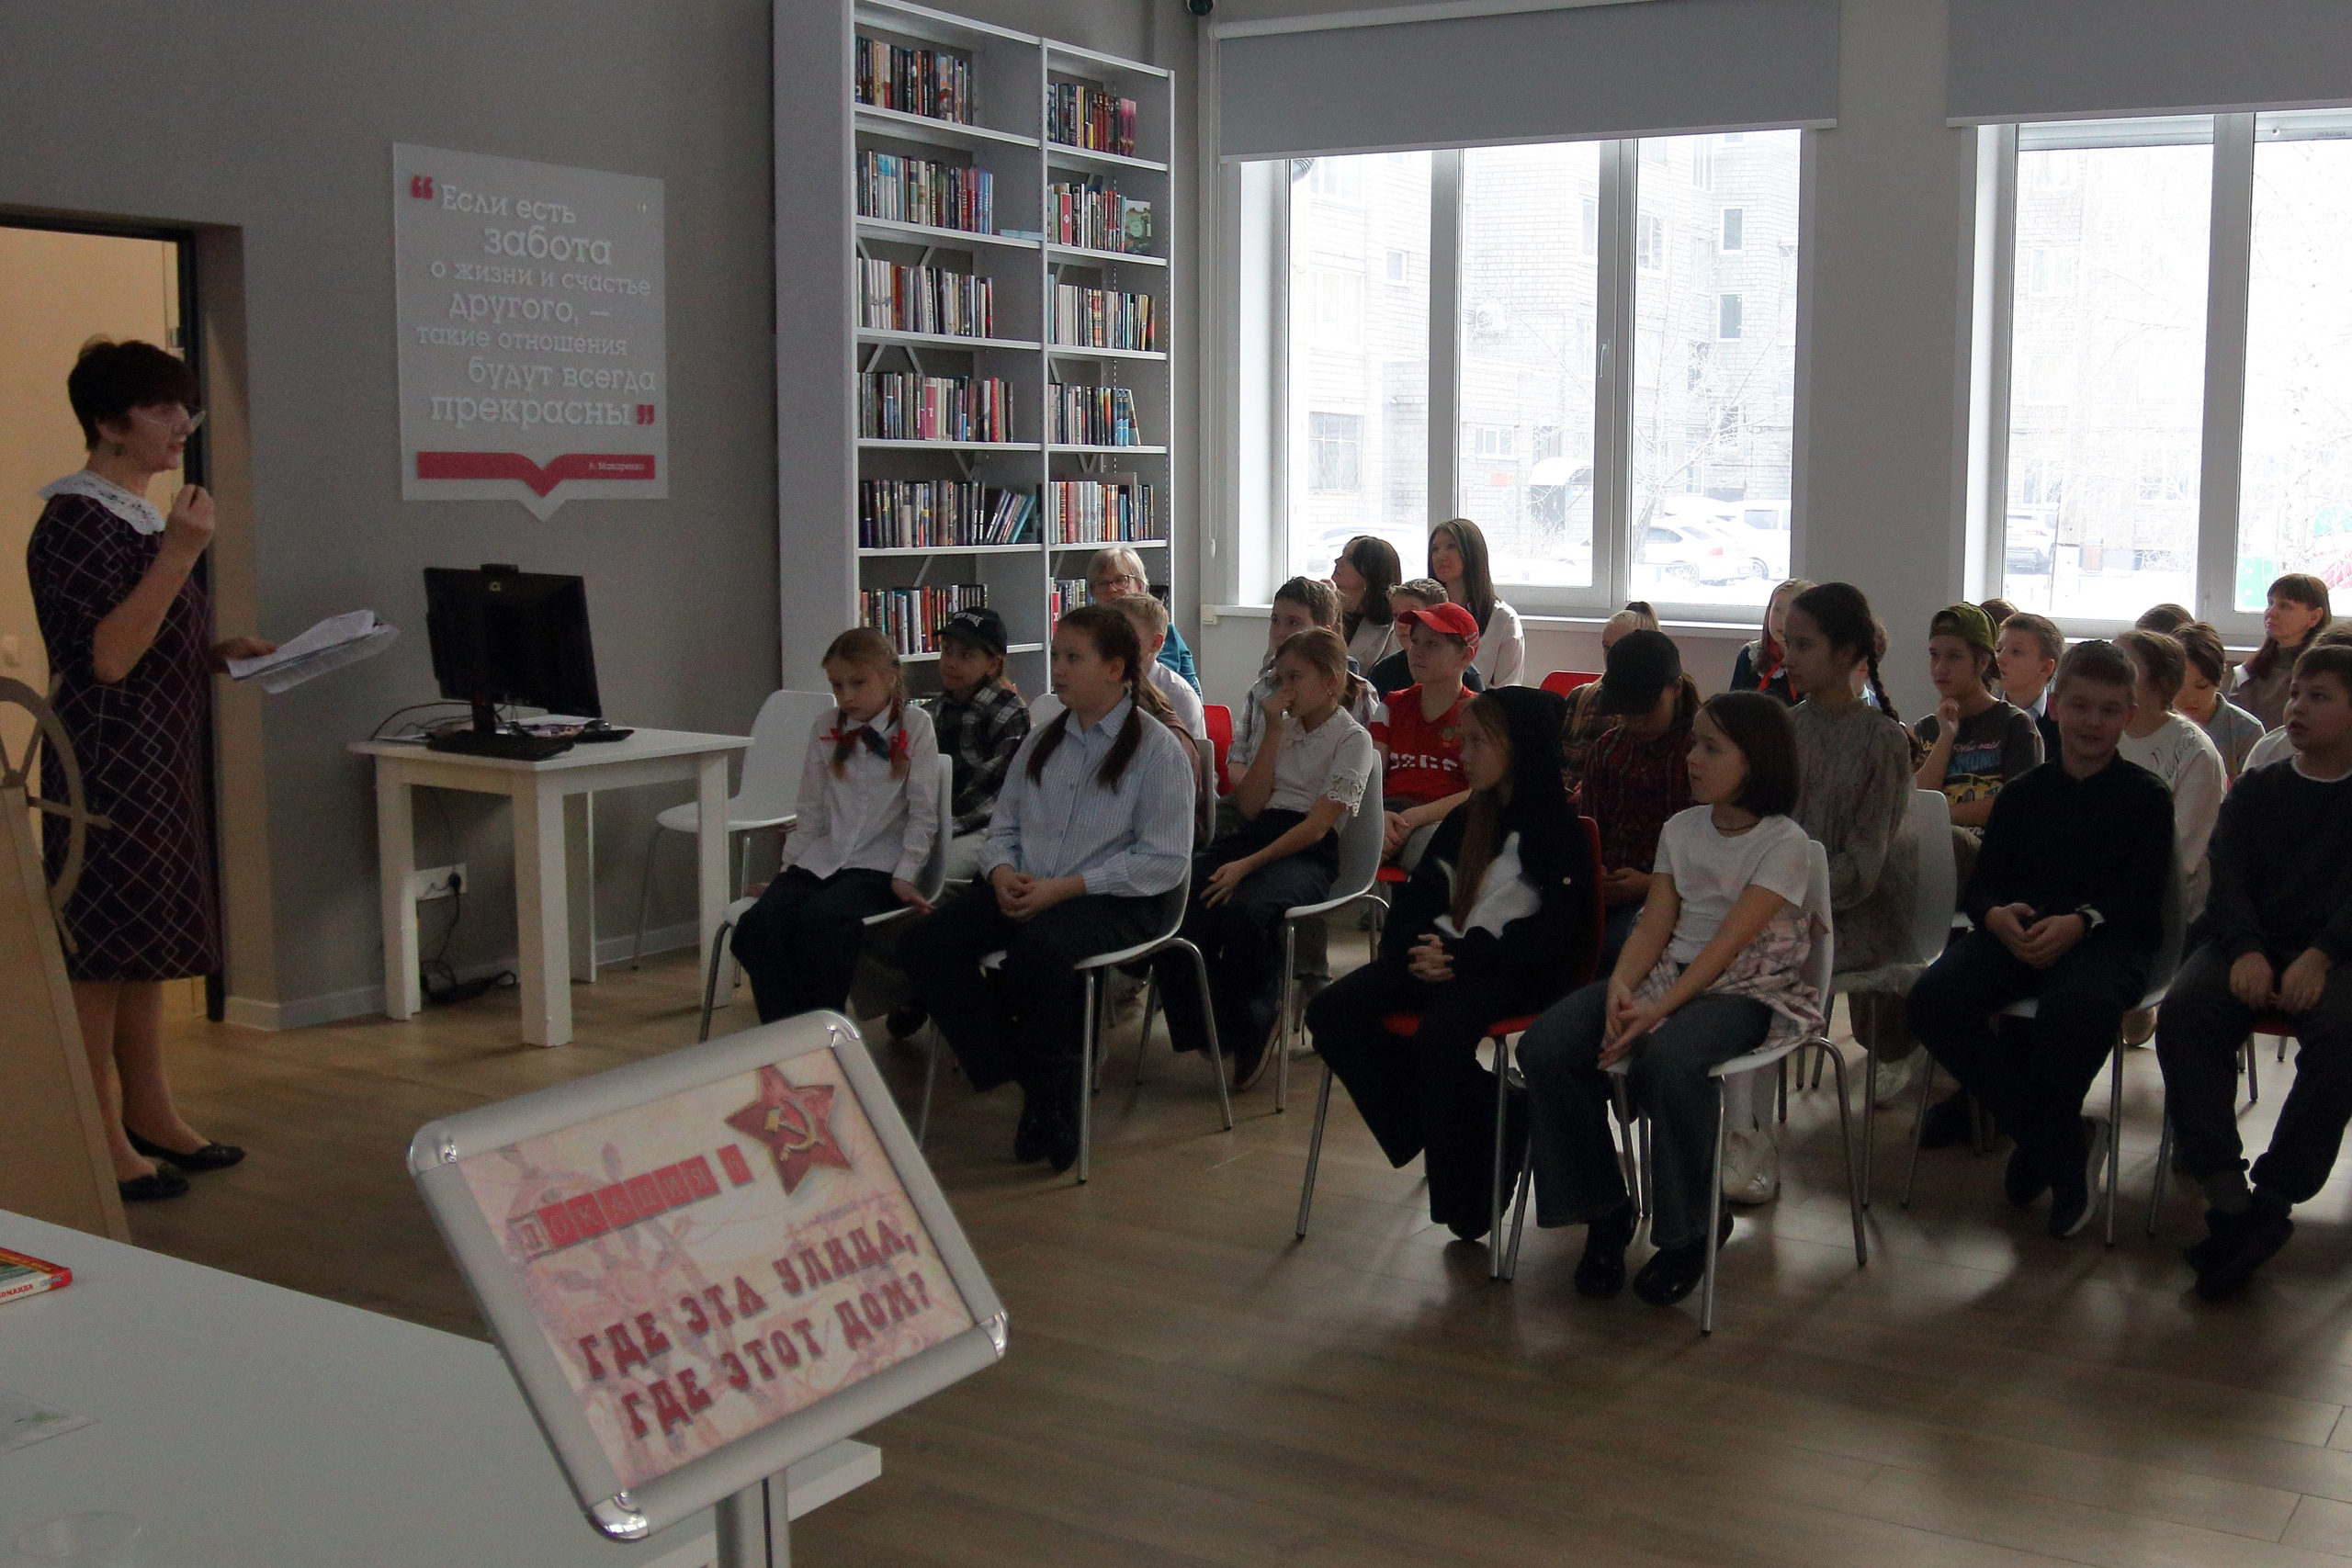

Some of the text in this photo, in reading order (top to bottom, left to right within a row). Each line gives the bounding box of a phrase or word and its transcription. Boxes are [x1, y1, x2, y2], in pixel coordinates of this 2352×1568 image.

[516, 198, 577, 224] есть
[483, 225, 614, 265] забота
[430, 261, 650, 296] о жизни и счастье
[448, 292, 580, 325] другого,
[416, 325, 628, 355] такие отношения
[468, 356, 655, 395] будут всегда
[518, 1163, 714, 1250] ЛОКАЦИЯ
[0, 1282, 34, 1299] ОМАНДА
[577, 1218, 920, 1382] ГДЕ ЭТА УЛИЦА,
[621, 1270, 931, 1438] ГДЕ ЭТОТ ДОМ?
